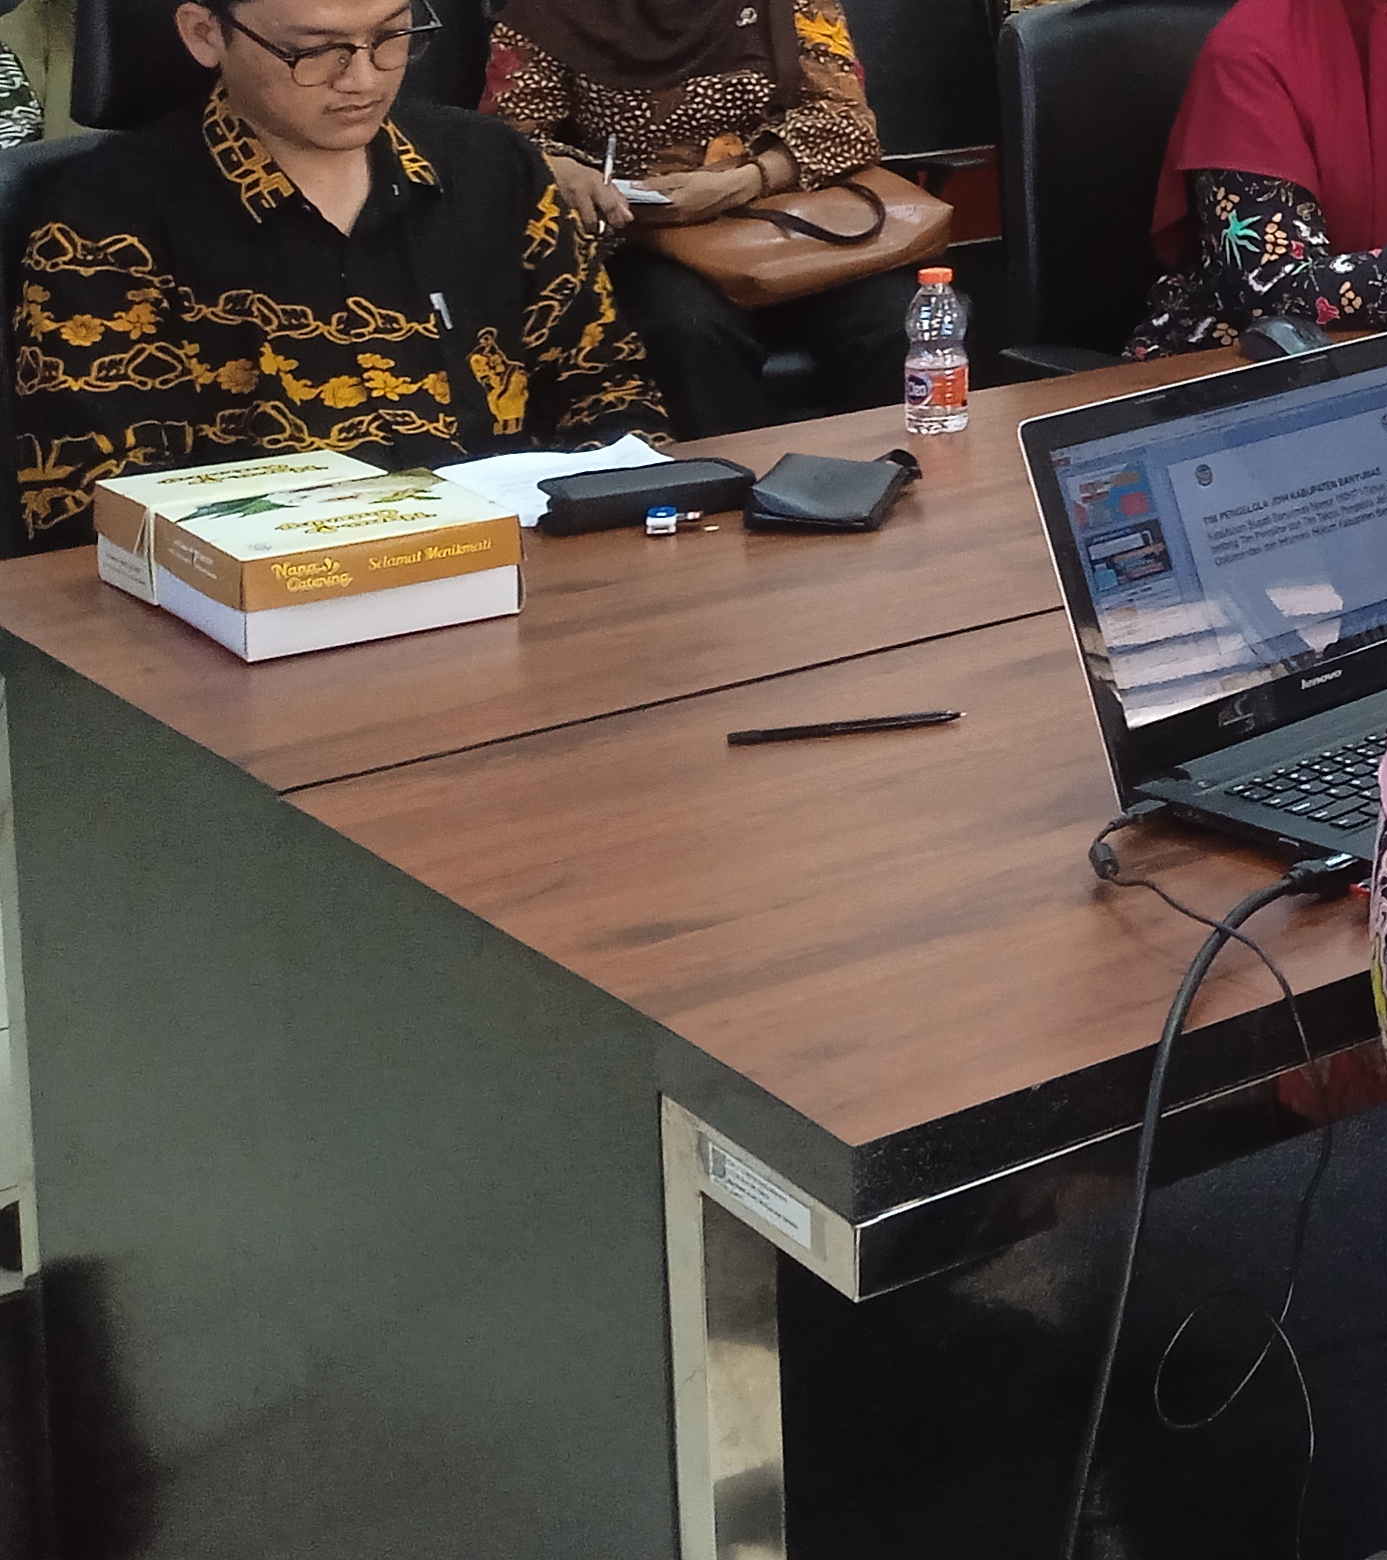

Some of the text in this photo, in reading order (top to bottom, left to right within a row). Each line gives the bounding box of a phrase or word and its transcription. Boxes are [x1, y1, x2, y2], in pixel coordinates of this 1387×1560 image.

[368, 538, 491, 571] Selamat Menikmati
[271, 562, 320, 580] Nana
[286, 572, 353, 592] Catering
